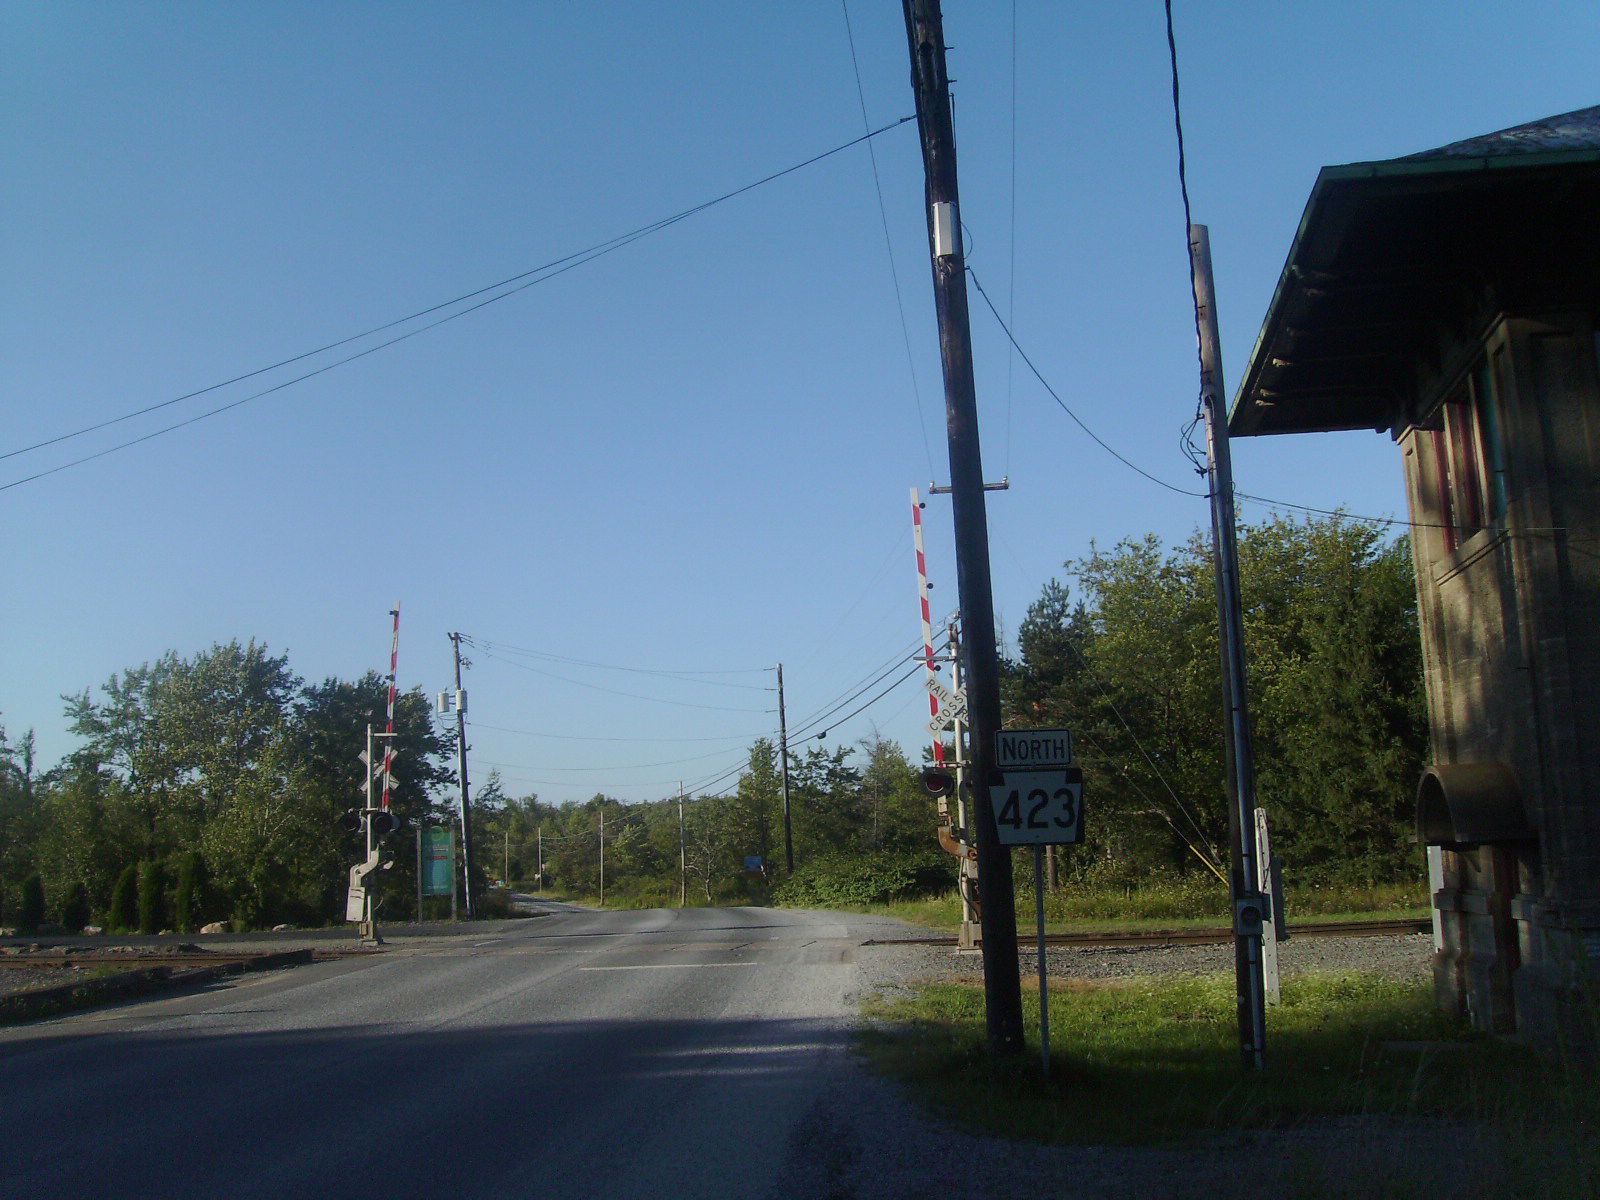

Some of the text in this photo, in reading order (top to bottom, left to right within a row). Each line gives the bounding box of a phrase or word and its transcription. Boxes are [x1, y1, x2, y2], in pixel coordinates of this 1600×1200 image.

[926, 679, 947, 702] RAIL
[929, 687, 968, 731] CROSSI
[1002, 737, 1065, 760] NORTH
[998, 788, 1075, 829] 423
